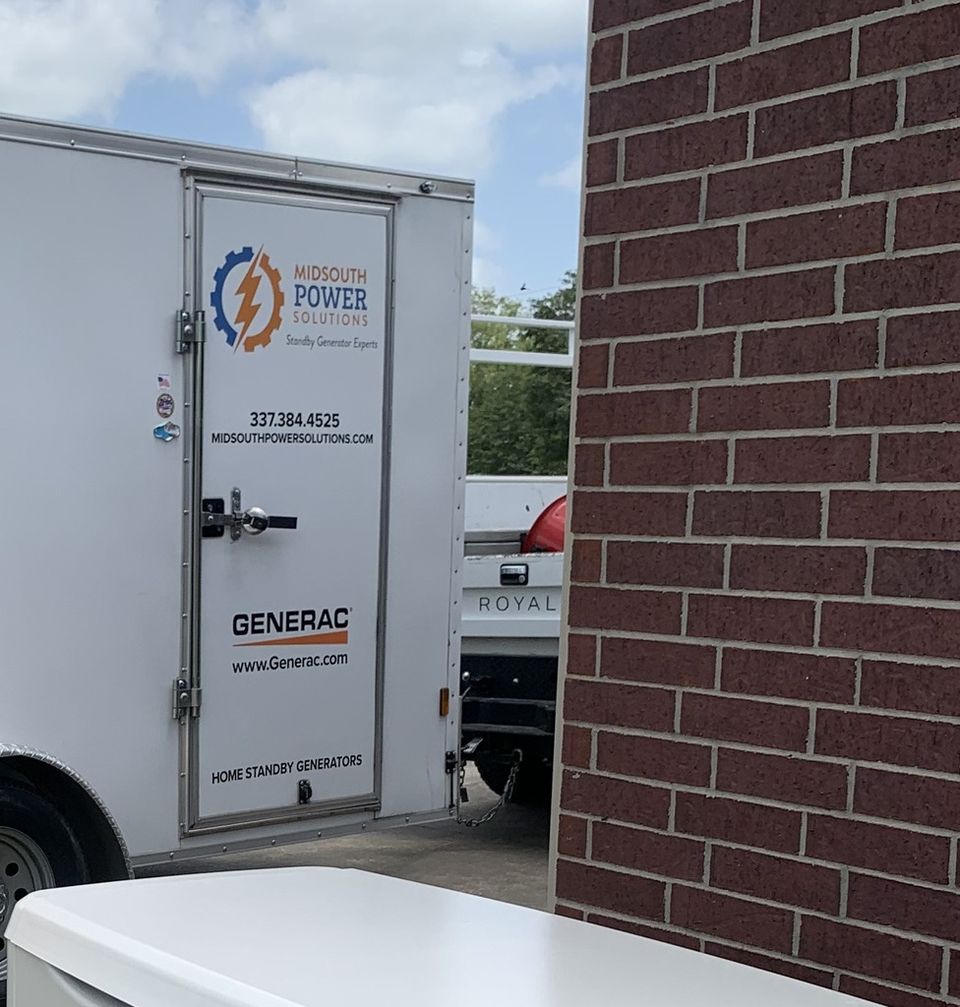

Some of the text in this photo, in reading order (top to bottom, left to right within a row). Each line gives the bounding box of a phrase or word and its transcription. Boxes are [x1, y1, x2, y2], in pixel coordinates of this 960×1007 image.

[294, 264, 367, 284] MIDSOUTH
[294, 284, 368, 310] POWER
[293, 311, 368, 327] SOLUTIONS
[286, 334, 378, 352] Standby Generator Experts
[250, 412, 340, 428] 337.384.4525
[211, 432, 374, 444] MIDSOUTHPOWERSOLUTIONS.COM
[479, 595, 557, 612] ROYAL
[233, 607, 349, 636] GENERAC
[232, 653, 348, 674] www.Generac.com
[211, 754, 363, 785] HOME STANDBY GENERATORS
